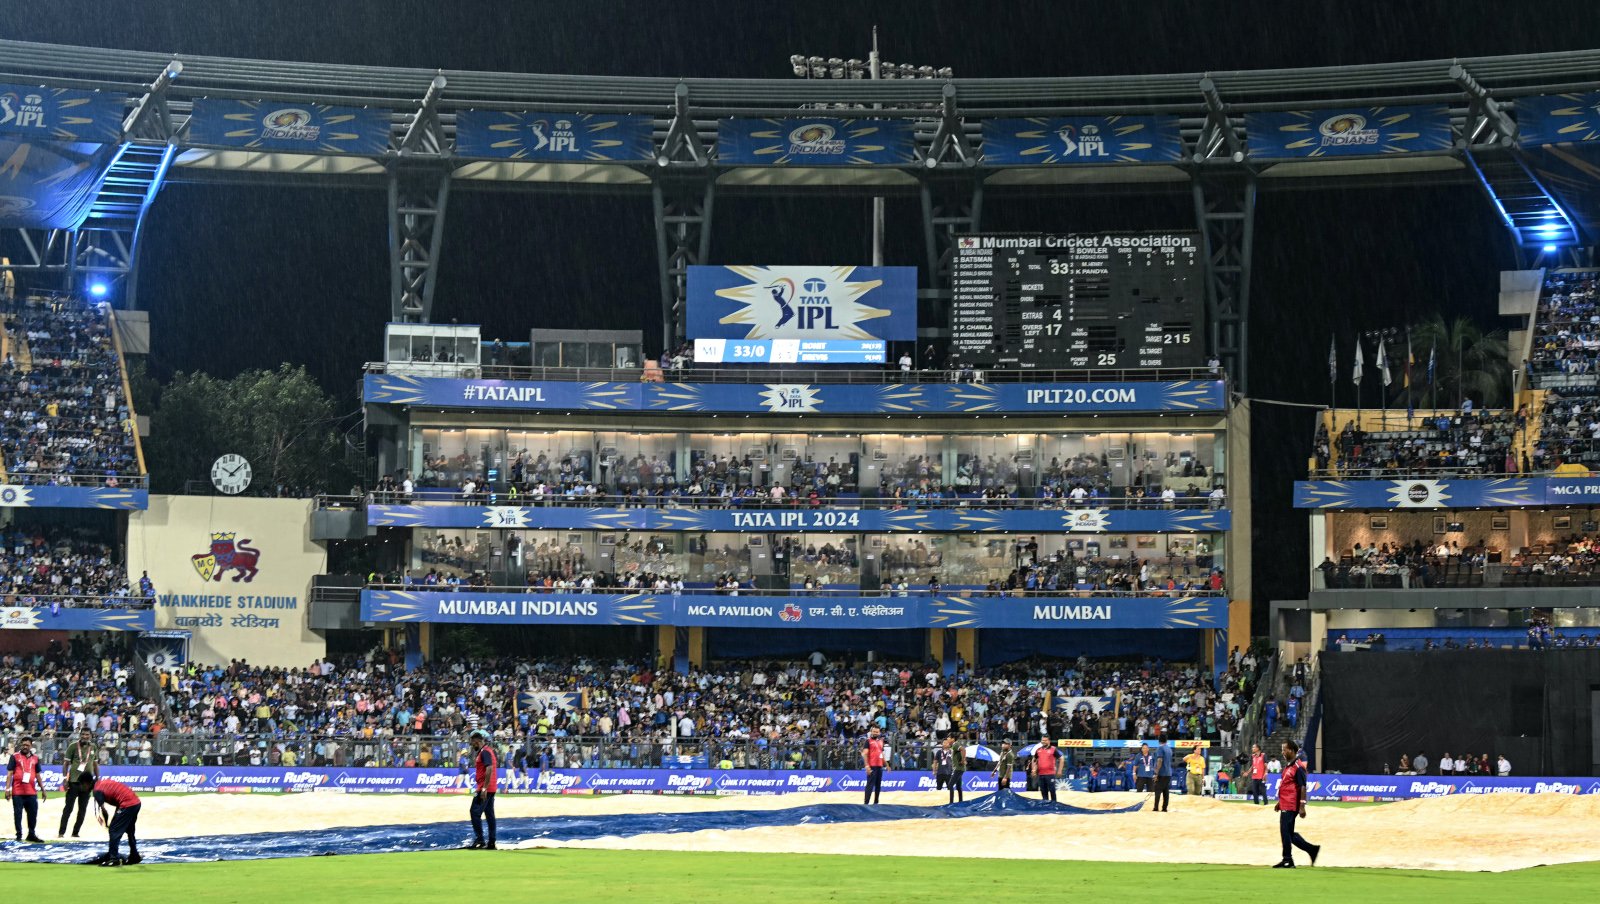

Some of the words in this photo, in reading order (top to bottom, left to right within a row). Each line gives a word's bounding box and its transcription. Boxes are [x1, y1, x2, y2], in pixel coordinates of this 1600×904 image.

[15, 111, 47, 128] IPL
[261, 128, 320, 140] INDIANS
[1321, 134, 1379, 146] INDIANS
[549, 136, 580, 152] IPL
[789, 144, 846, 155] INDIANS
[1078, 141, 1110, 157] IPL
[983, 236, 1041, 248] Mumbai
[1045, 235, 1099, 248] Cricket
[1101, 235, 1191, 247] Association
[1050, 262, 1069, 275] 33
[1021, 283, 1044, 291] WICKETS
[799, 296, 830, 305] TATA
[797, 306, 840, 330] IPL
[1021, 311, 1044, 320] EXTRAS
[1052, 309, 1063, 321] 4
[1044, 323, 1063, 336] 17
[1144, 335, 1163, 343] TARGET
[1163, 333, 1191, 344] 215
[733, 345, 766, 358] 33/0
[1097, 353, 1117, 366] 25
[463, 385, 546, 402] #TATAIPL
[1027, 388, 1136, 404] IPLT20.COM
[788, 398, 805, 408] IPL
[1554, 485, 1582, 495] MCA
[505, 517, 517, 525] IPL
[731, 512, 777, 527] TATA
[780, 512, 808, 527] IPL
[812, 511, 860, 527] 2024
[197, 559, 205, 567] M
[207, 558, 214, 567] C
[203, 568, 210, 576] A
[158, 594, 232, 609] WANKHEDE
[237, 596, 297, 609] STADIUM
[438, 599, 516, 615] MUMBAI
[521, 600, 598, 616] INDIANS
[687, 605, 715, 616] MCA
[718, 606, 774, 617] PAVILION
[1033, 605, 1112, 620] MUMBAI
[230, 614, 280, 629] स्टेडियम
[161, 771, 203, 786] RuPay
[215, 776, 233, 784] LINK
[233, 776, 242, 784] IT
[242, 776, 273, 784] FORGET
[272, 776, 281, 784] IT
[283, 771, 324, 786] RuPay
[340, 777, 358, 785] LINK
[358, 777, 366, 785] IT
[365, 777, 395, 785] FORGET
[395, 777, 404, 785] IT
[416, 773, 456, 787] RuPay
[591, 778, 609, 786] LINK
[608, 778, 617, 786] IT
[617, 778, 646, 786] FORGET
[645, 778, 656, 786] IT
[667, 774, 708, 788] RuPay
[720, 779, 739, 787] LINK
[739, 779, 747, 787] IT
[746, 779, 776, 787] FORGET
[775, 779, 785, 787] IT
[787, 774, 828, 788] RuPay
[842, 780, 860, 788] LINK
[898, 780, 906, 788] IT
[971, 780, 989, 788] LINK
[989, 780, 999, 788] IT
[1331, 784, 1350, 793] LINK
[1350, 784, 1359, 793] IT
[1358, 784, 1389, 793] FORGET
[1388, 784, 1398, 793] IT
[1410, 781, 1452, 796] RuPay
[1465, 786, 1484, 794] LINK
[1483, 786, 1493, 794] IT
[1492, 786, 1521, 794] FORGET
[1521, 786, 1531, 794] IT
[1534, 782, 1576, 794] RuPay
